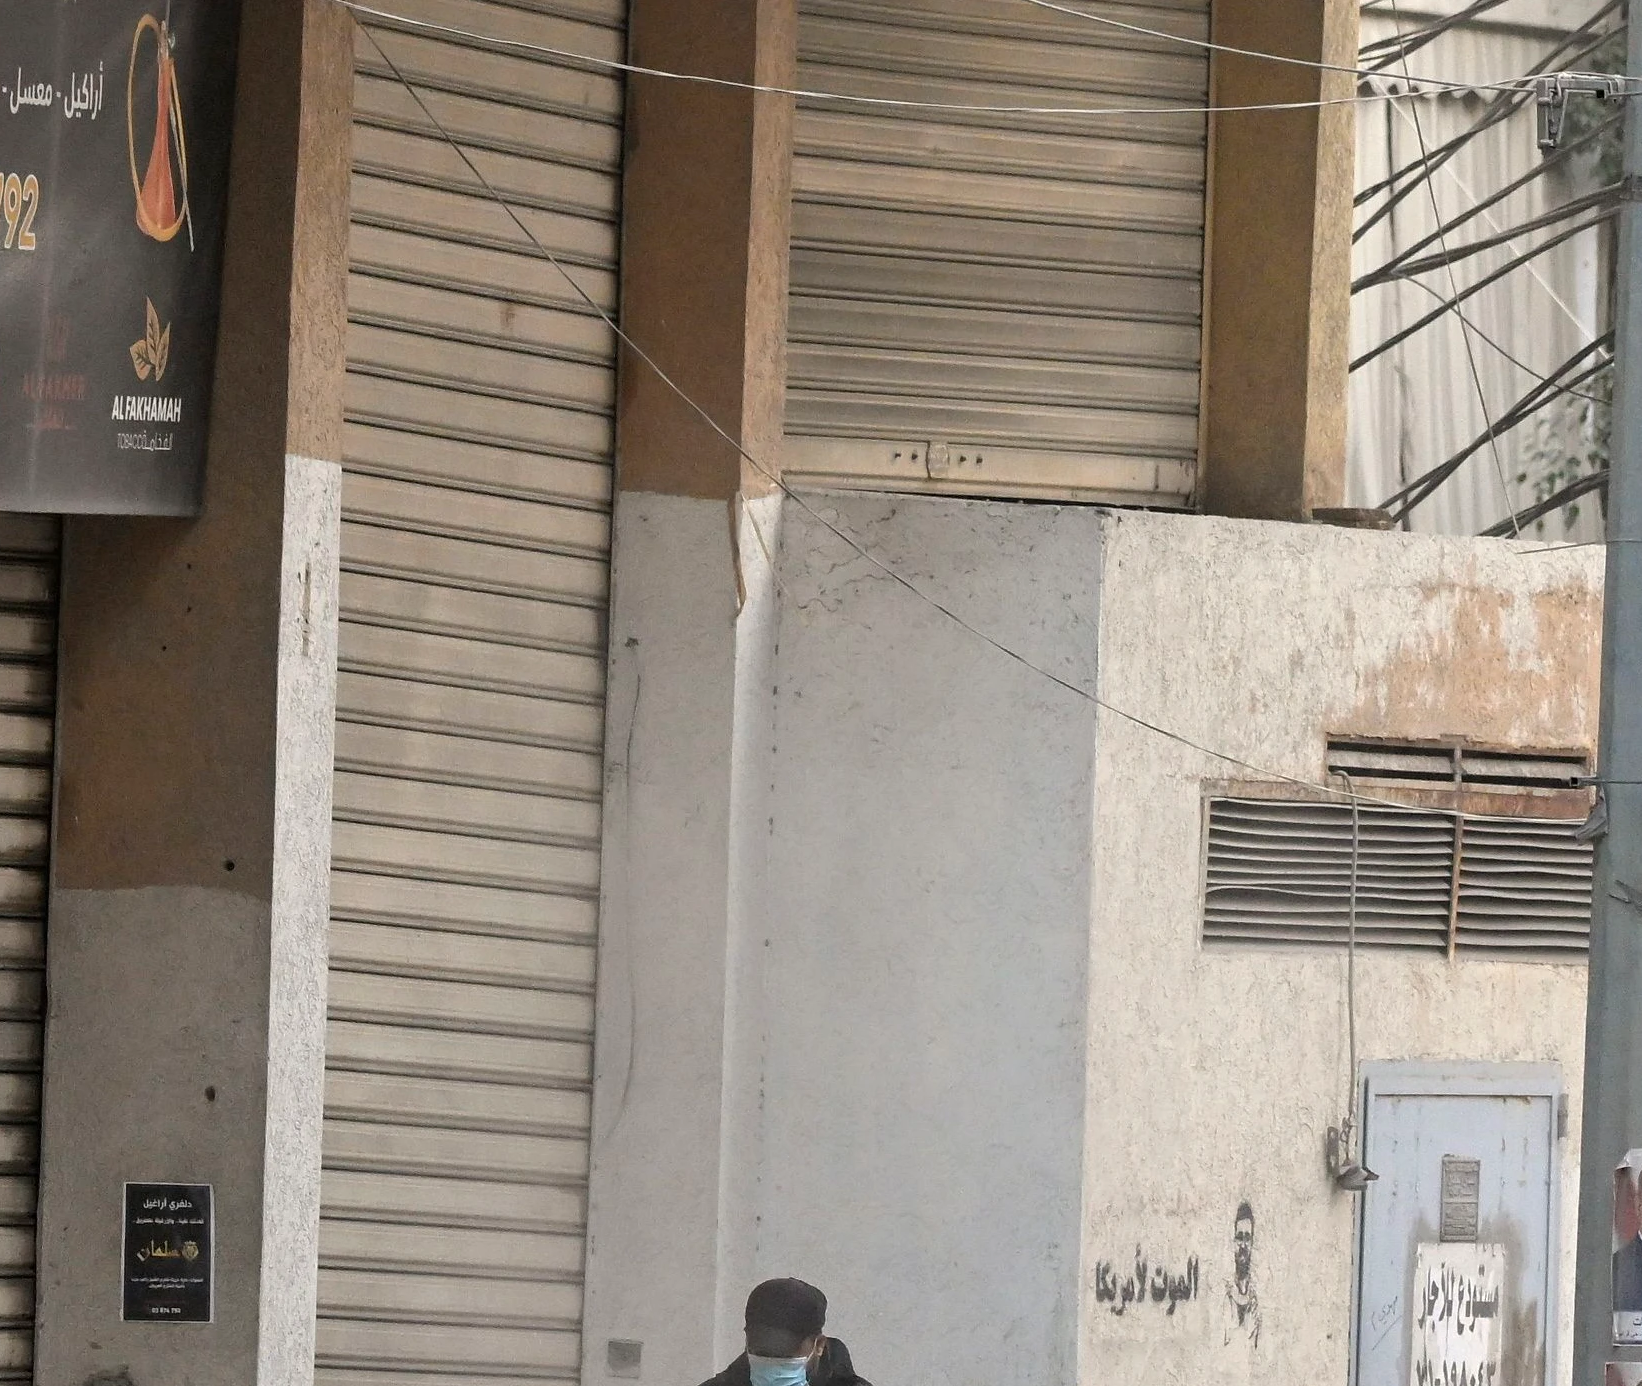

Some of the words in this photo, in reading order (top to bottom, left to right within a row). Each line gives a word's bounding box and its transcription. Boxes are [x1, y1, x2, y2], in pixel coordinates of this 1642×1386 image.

[10, 67, 53, 114] معسل
[64, 61, 103, 120] أراكيل
[1151, 1254, 1199, 1315] الموت
[1457, 1263, 1499, 1336] مستودع
